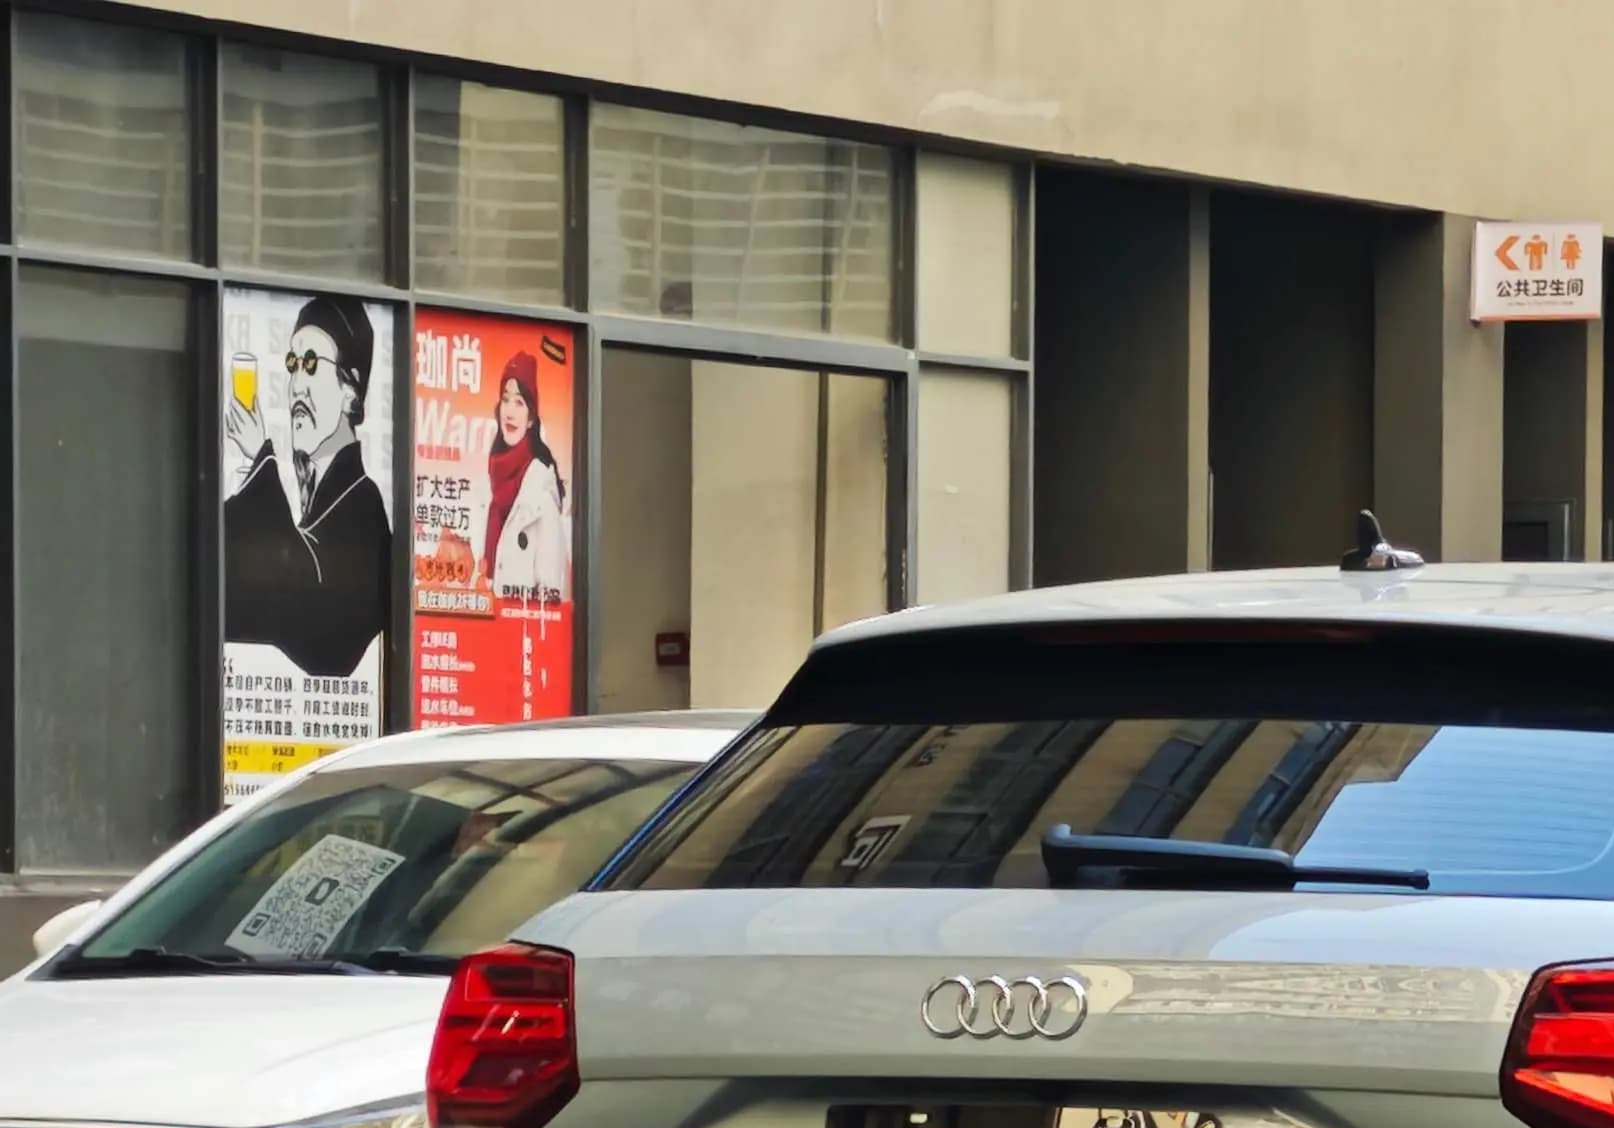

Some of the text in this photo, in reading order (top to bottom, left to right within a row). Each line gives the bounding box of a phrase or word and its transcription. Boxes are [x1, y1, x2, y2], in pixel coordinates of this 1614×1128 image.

[1496, 278, 1584, 298] 公共卫生间
[416, 329, 482, 394] 珈尚
[416, 474, 470, 500] 扩大生产
[416, 503, 471, 530] 单款过万
